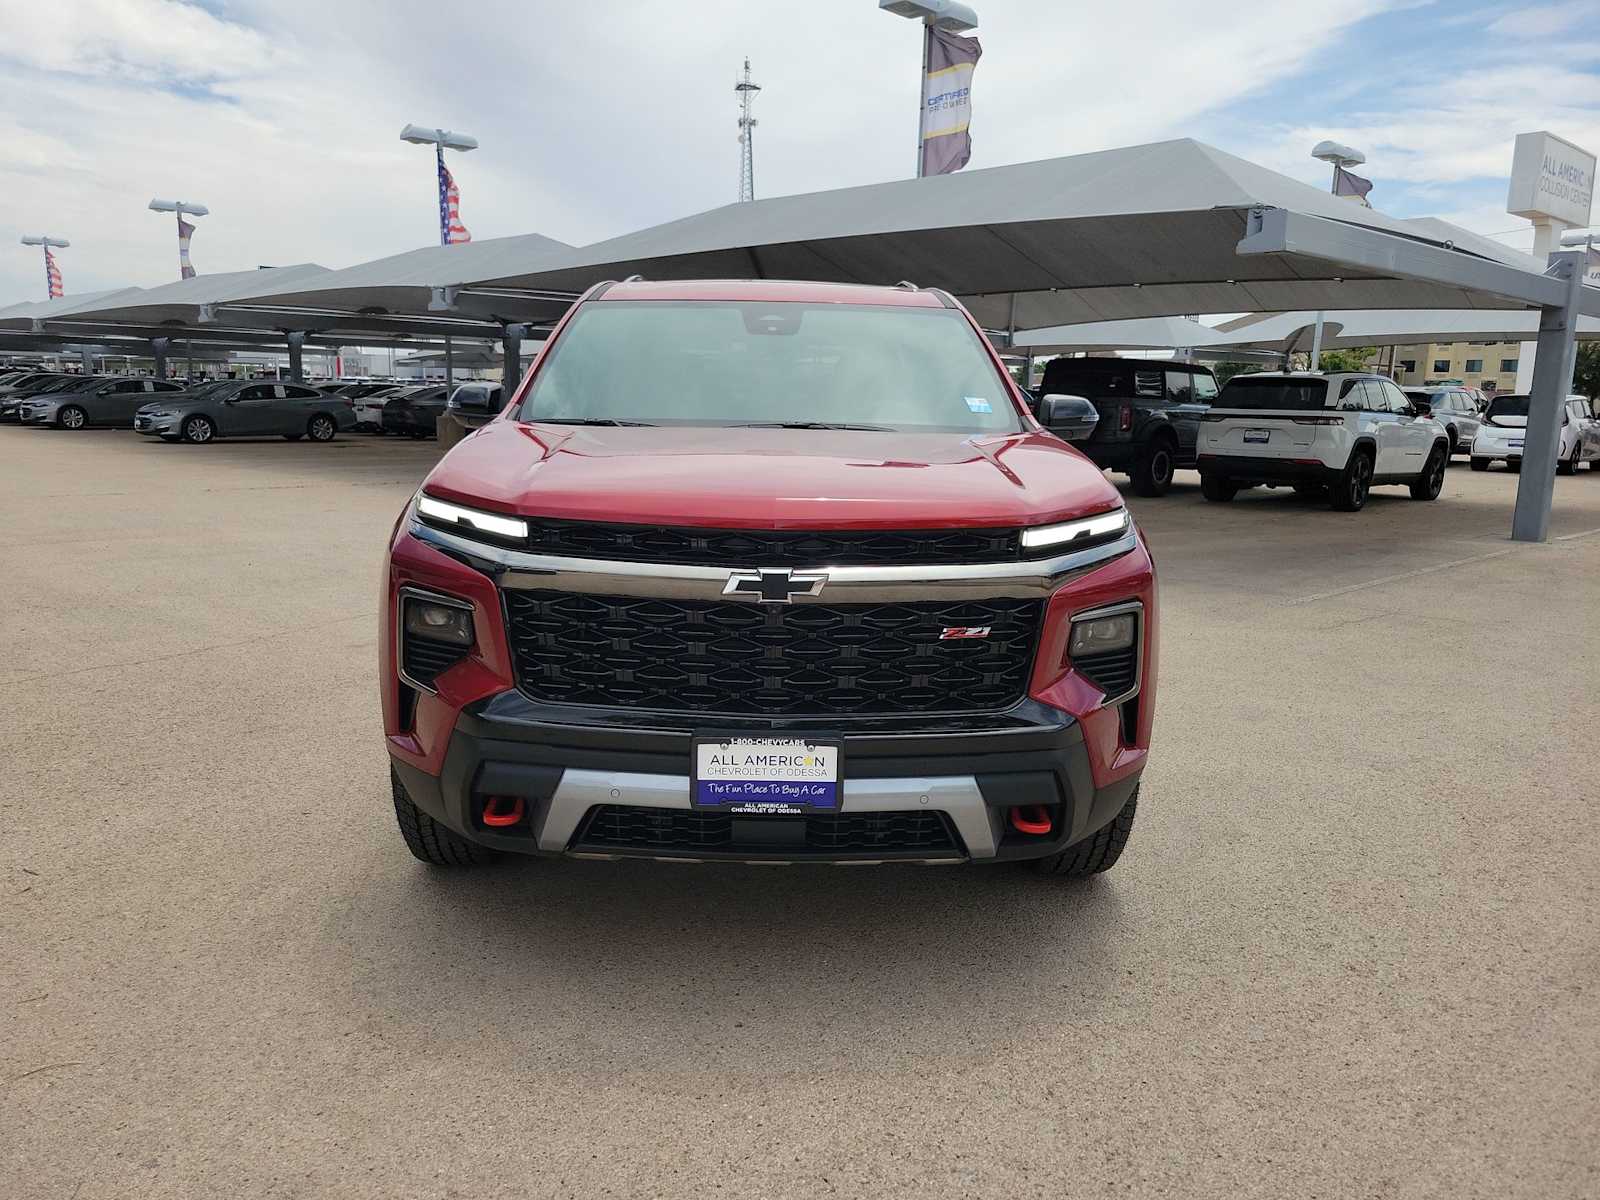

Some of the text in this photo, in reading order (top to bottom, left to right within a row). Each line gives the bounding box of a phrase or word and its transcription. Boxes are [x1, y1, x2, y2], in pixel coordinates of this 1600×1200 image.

[1542, 153, 1591, 187] ALL AMERICN
[710, 754, 825, 767] ALL AMERICN
[707, 767, 828, 777] CHEVROLET OF ODESSA
[708, 782, 826, 797] The Fun Place To Buy A Car
